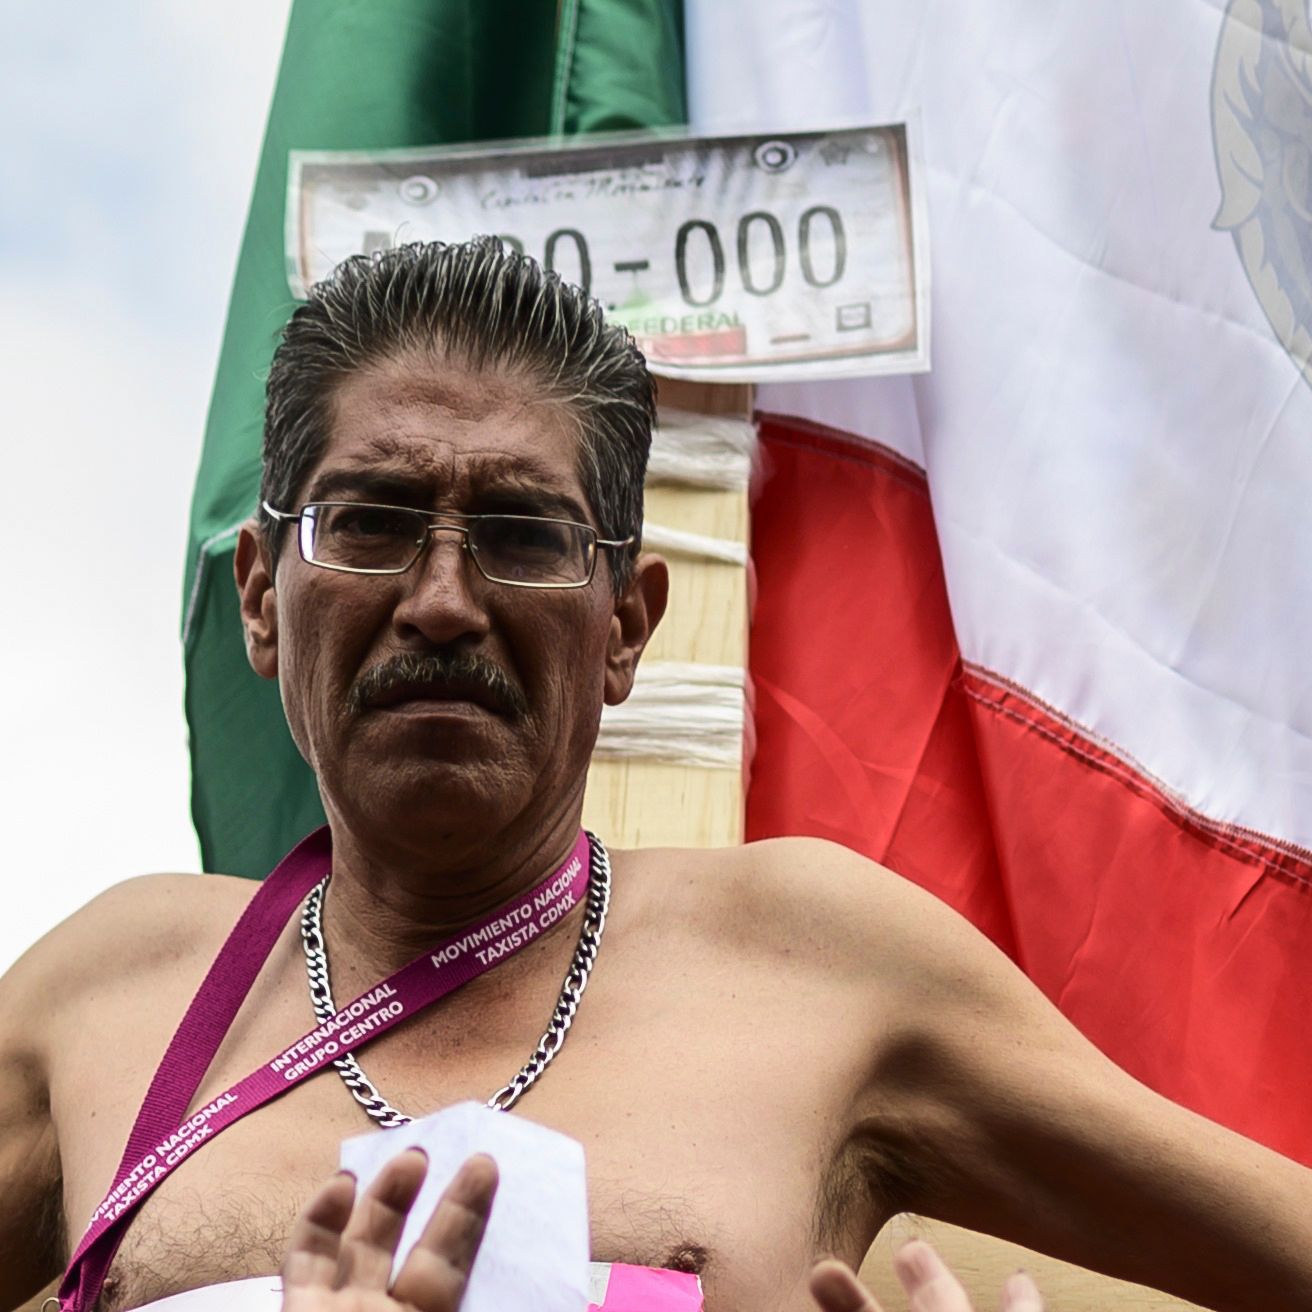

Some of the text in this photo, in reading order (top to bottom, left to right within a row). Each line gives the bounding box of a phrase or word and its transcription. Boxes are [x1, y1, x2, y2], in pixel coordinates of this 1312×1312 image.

[431, 857, 582, 969] MOVIMIENTO NACIONAL
[475, 891, 576, 966] TAXISTA CDMX
[270, 983, 398, 1073] INTERNACIONAL
[284, 1001, 404, 1081] GRUPO CENTRO
[89, 1092, 238, 1228] VIMIENTO NACIONAL
[104, 1124, 213, 1221] TAXISTA CDMX
